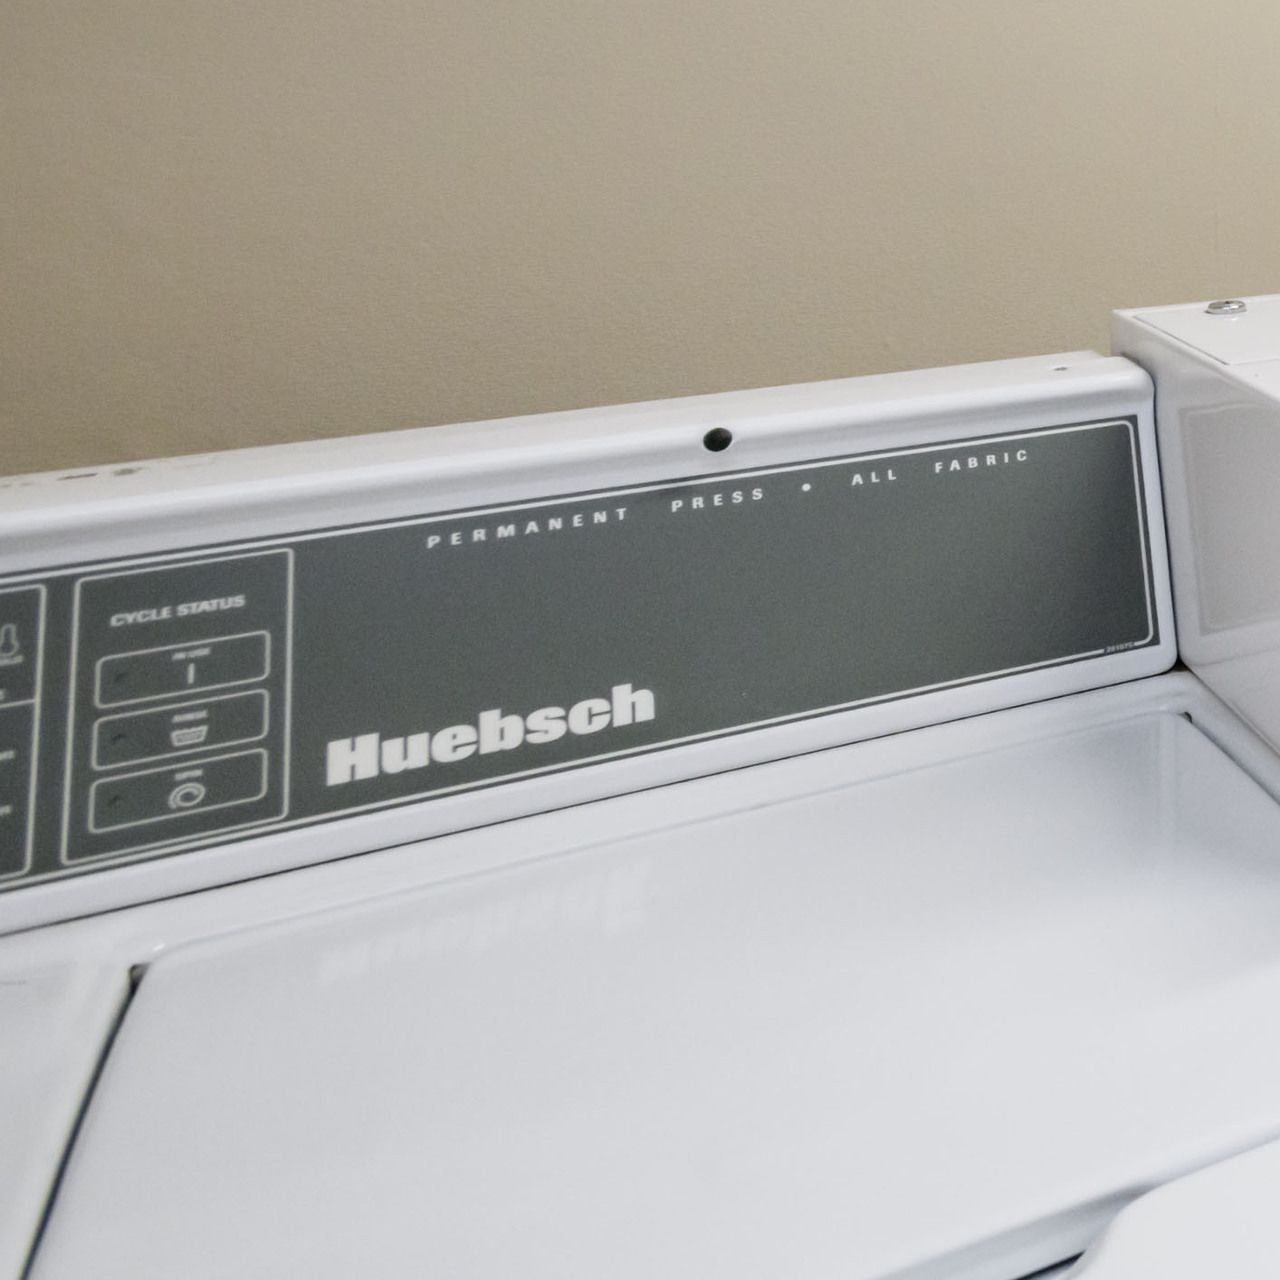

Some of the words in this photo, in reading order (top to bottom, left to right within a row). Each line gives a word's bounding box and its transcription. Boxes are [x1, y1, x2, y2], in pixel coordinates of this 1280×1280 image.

[427, 507, 627, 549] PERMANENT
[671, 487, 763, 513] PRESS
[851, 469, 897, 486] ALL
[934, 449, 1027, 474] FABRIC
[110, 606, 172, 627] CYCLE
[176, 594, 246, 617] STATUS
[326, 683, 656, 784] Huebsch
